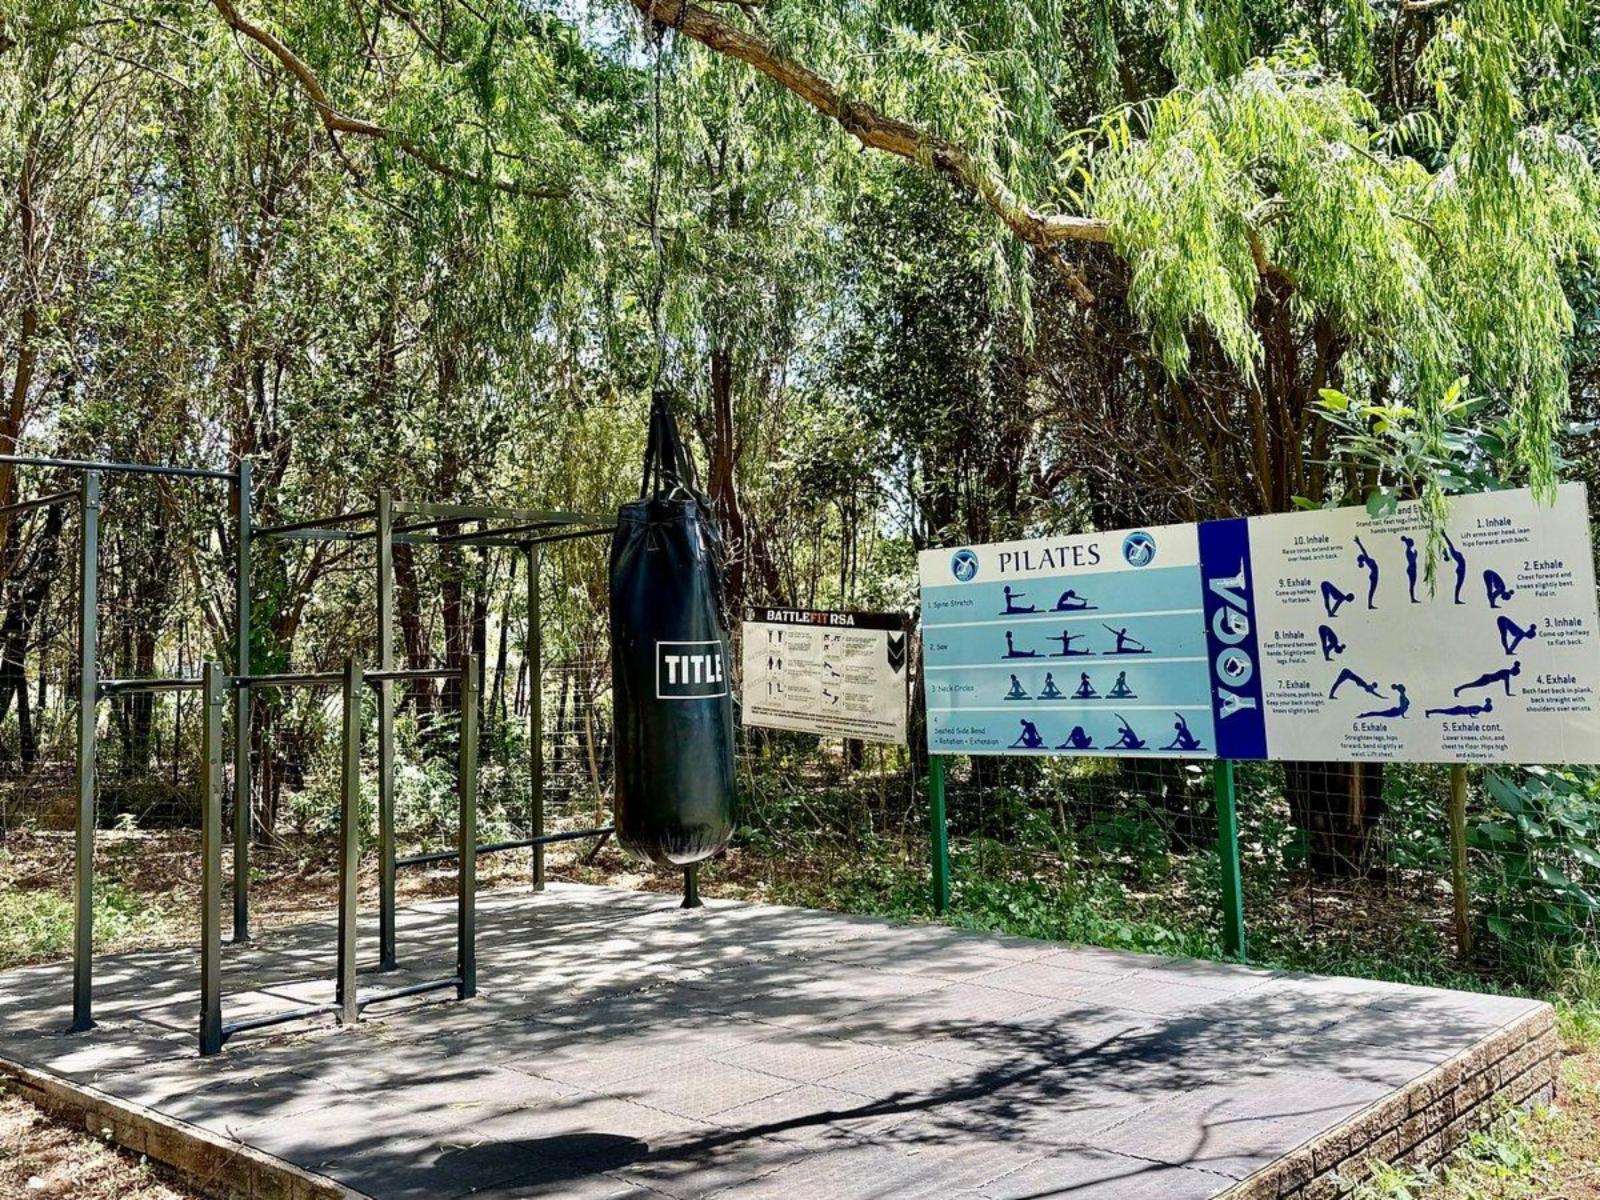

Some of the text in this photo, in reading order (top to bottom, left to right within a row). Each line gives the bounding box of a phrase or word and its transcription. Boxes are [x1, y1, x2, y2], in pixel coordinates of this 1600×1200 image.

[1477, 517, 1512, 528] 1. Inhale
[1294, 534, 1329, 545] 10. Inhale
[1000, 543, 1101, 573] PILATES
[1524, 559, 1563, 571] 2. Exhale
[1278, 577, 1311, 588] 9. Exhale
[934, 600, 949, 609] Spine
[950, 599, 974, 608] Stretch
[767, 610, 855, 626] BATTLEFIT RSA
[1544, 616, 1582, 628] 3. Inhale
[1208, 556, 1257, 720] YOGA
[1274, 630, 1305, 640] 8. Inhale
[665, 654, 723, 685] TITLE
[1278, 679, 1310, 689] 7. Exhale
[1536, 674, 1576, 684] 4. Exhale
[954, 684, 975, 692] Circles
[934, 726, 986, 735] Seated Side Bend
[1353, 722, 1388, 732] 6. Exhale
[1442, 722, 1504, 732] 5. Exhale cont.
[939, 736, 1000, 745] Rotation Extension
